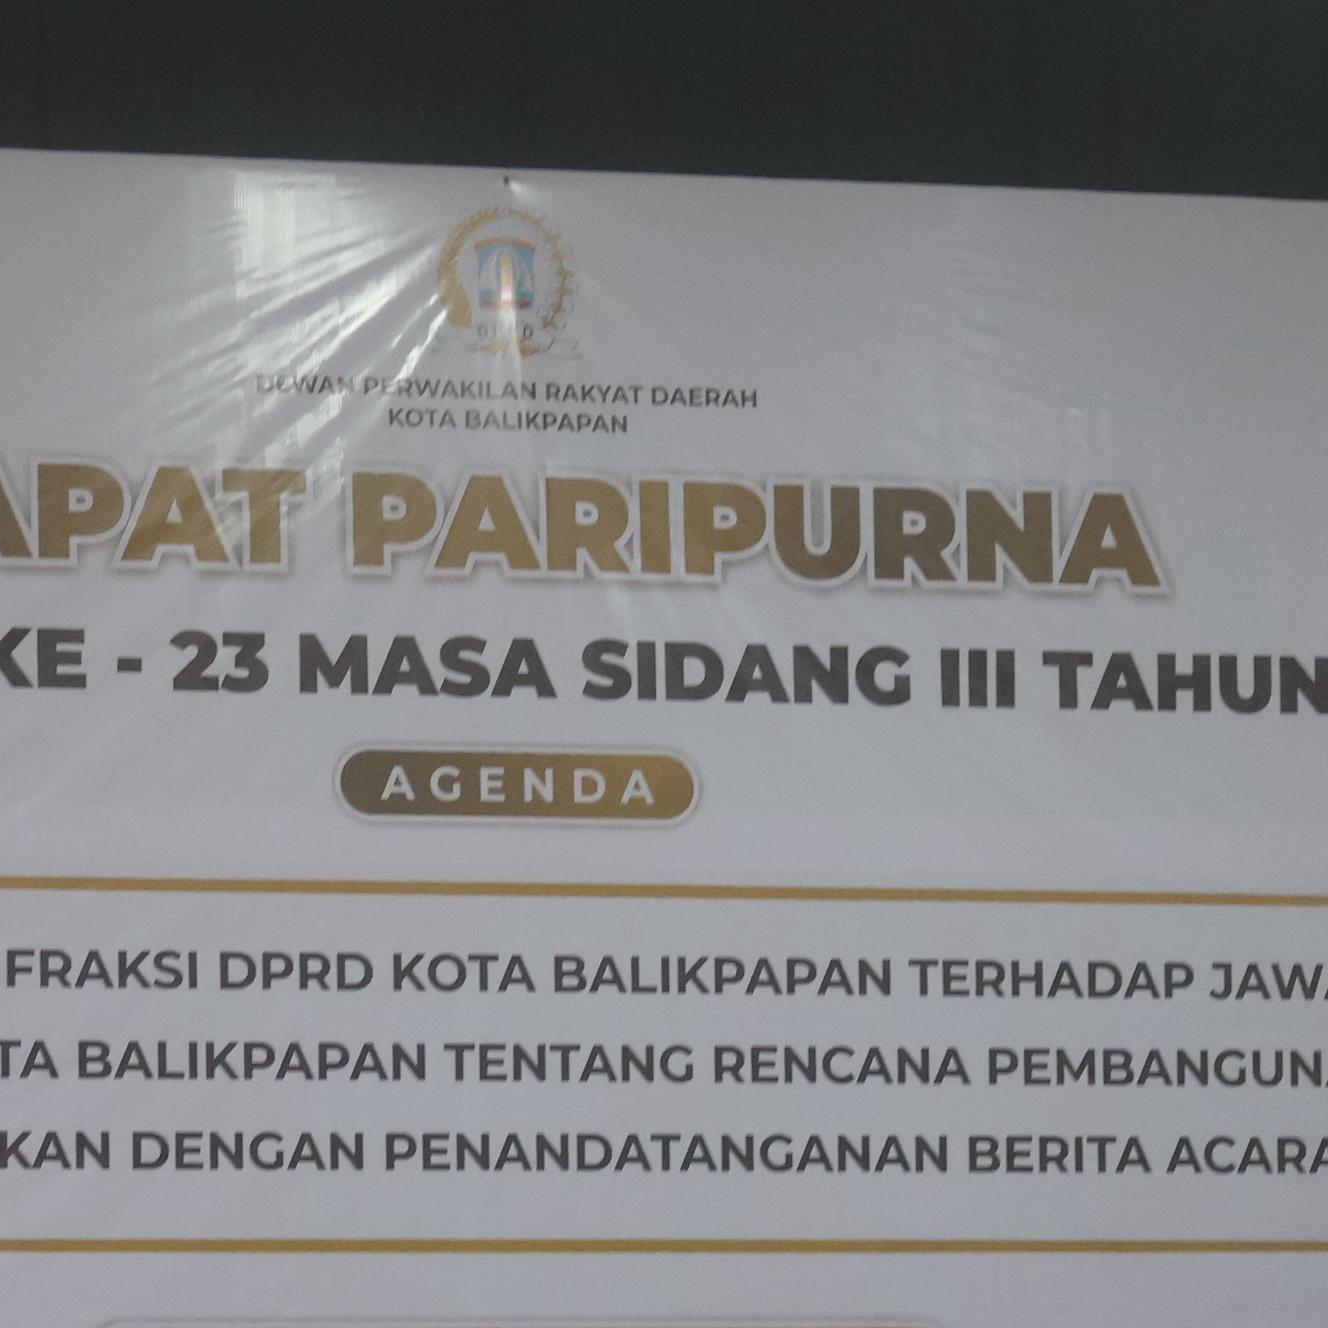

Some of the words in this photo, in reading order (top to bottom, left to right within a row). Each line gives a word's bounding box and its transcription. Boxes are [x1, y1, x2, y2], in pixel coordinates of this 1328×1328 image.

[255, 373, 355, 395] DEWAN
[362, 376, 537, 400] PERWAKILAN
[545, 381, 643, 405] RAKYAT
[650, 386, 758, 408] DAERAH
[388, 407, 457, 429] KOTA
[464, 409, 628, 434] BALIKPAPAN
[348, 469, 1163, 589] PARIPURNA
[116, 655, 143, 674] -
[168, 628, 270, 695] 23
[298, 632, 558, 699] MASA
[581, 637, 912, 709] SIDANG
[939, 646, 1017, 710] III
[380, 764, 655, 806] AGENDA
[5, 947, 199, 991] FRAKSI
[218, 950, 374, 993] DPRD
[392, 951, 537, 994] KOTA
[553, 953, 892, 998] BALIKPAPAN
[907, 957, 1195, 1001] TERHADAP
[77, 1038, 427, 1083] BALIKPAPAN
[442, 1041, 694, 1085] TENTANG
[713, 1044, 972, 1087] RENCANA
[131, 1130, 365, 1172] DENGAN
[384, 1130, 948, 1174] PENANDATANGANAN
[967, 1134, 1153, 1175] BERITA
